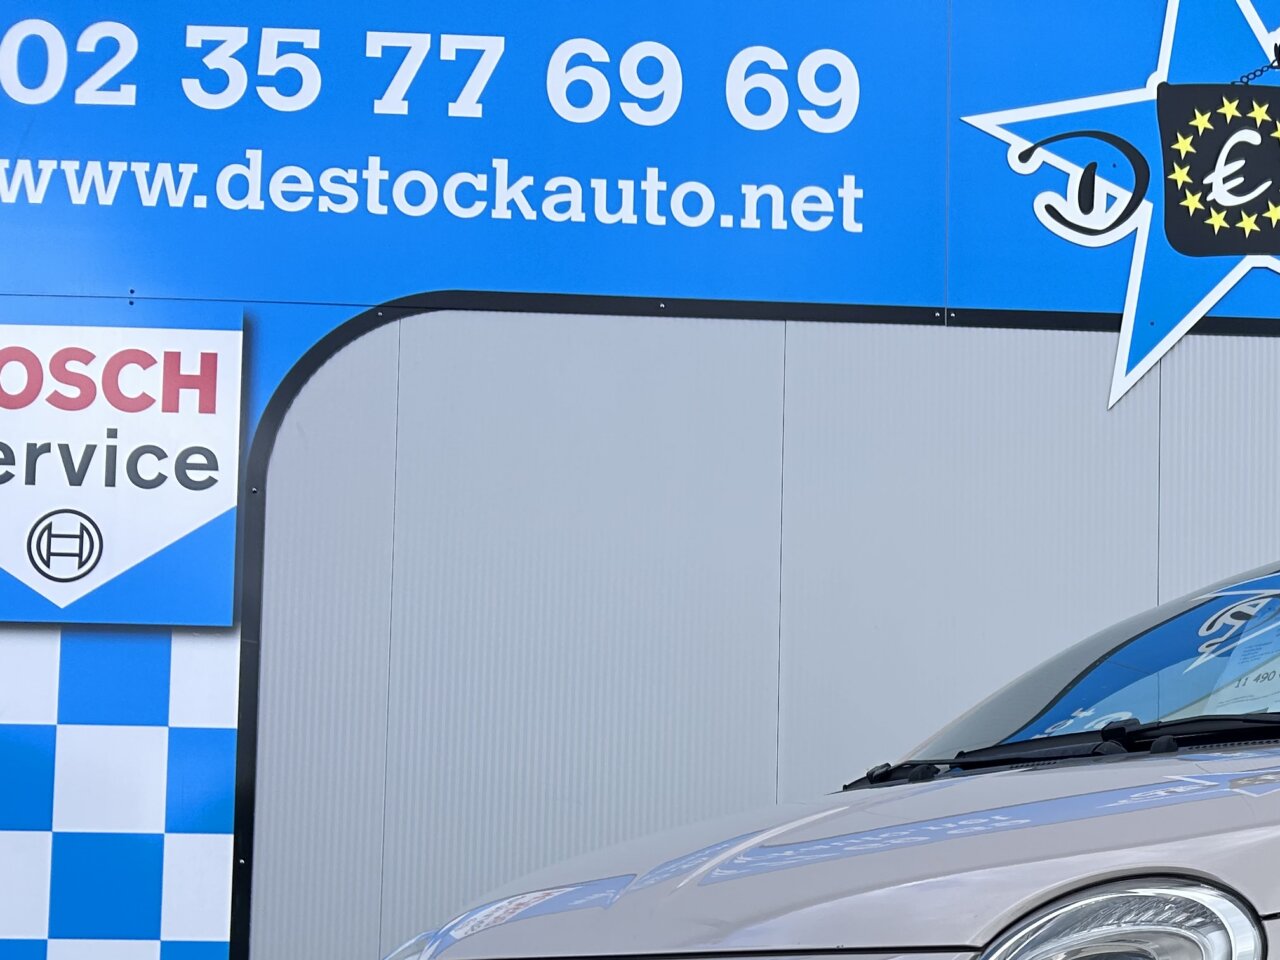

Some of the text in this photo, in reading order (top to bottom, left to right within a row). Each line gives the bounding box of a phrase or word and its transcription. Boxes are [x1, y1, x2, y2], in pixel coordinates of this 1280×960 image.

[0, 19, 860, 134] 02 35 77 69 69
[0, 149, 864, 233] www.destockauto.net
[1253, 670, 1277, 684] 490
